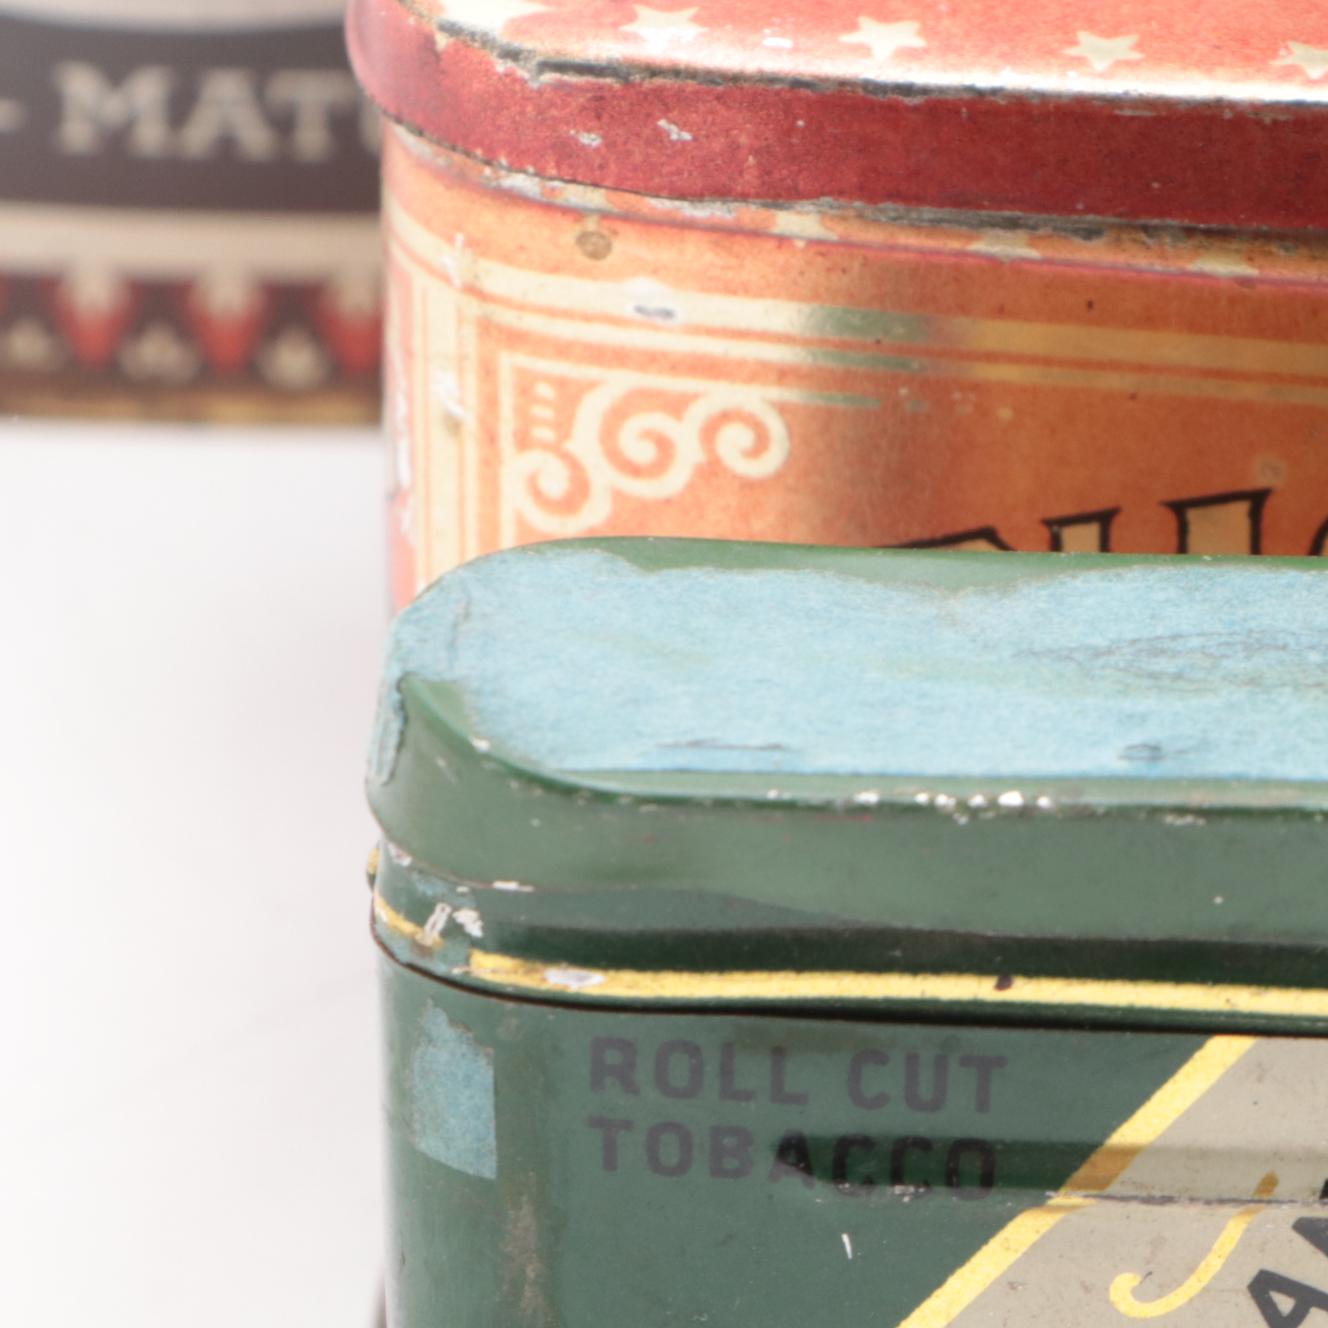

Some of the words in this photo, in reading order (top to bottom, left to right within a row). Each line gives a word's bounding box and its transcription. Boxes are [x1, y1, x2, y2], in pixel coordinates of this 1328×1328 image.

[54, 60, 384, 163] MAT
[588, 1036, 810, 1106] ROLL
[847, 1048, 1009, 1115] CUT
[588, 1115, 998, 1201] TOBACCO
